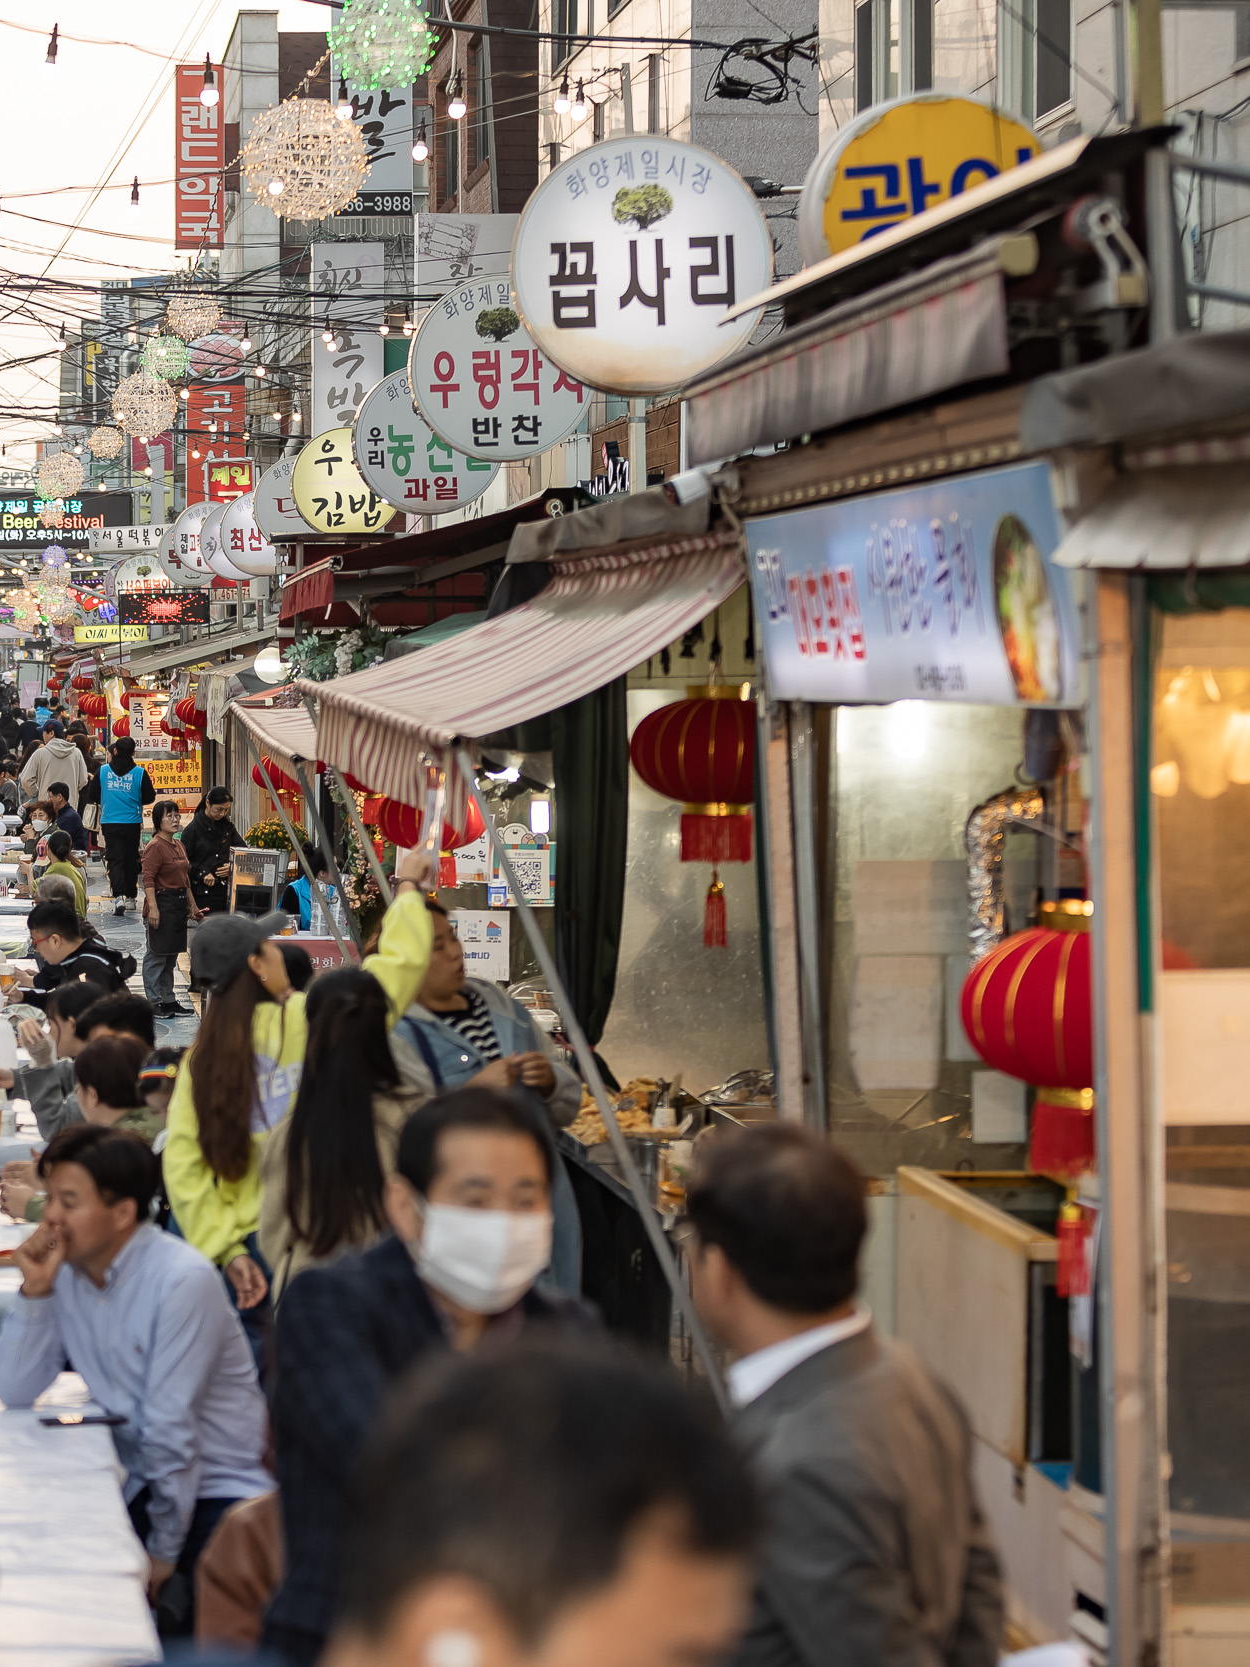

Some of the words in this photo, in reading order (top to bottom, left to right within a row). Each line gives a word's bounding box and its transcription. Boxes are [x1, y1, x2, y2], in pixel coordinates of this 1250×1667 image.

[565, 148, 713, 201] 화양제일시장
[341, 196, 411, 212] 66-3988
[548, 233, 737, 329] 꼽사리
[442, 283, 510, 321] 화양제일
[385, 376, 411, 402] 화양
[471, 413, 543, 447] 반찬
[210, 465, 251, 487] 제일
[404, 475, 458, 501] 과일
[3, 514, 40, 529] Beer
[44, 513, 105, 529] estival
[311, 491, 384, 528] 김밥
[230, 527, 271, 553] 최신
[132, 702, 145, 732] 즉석
